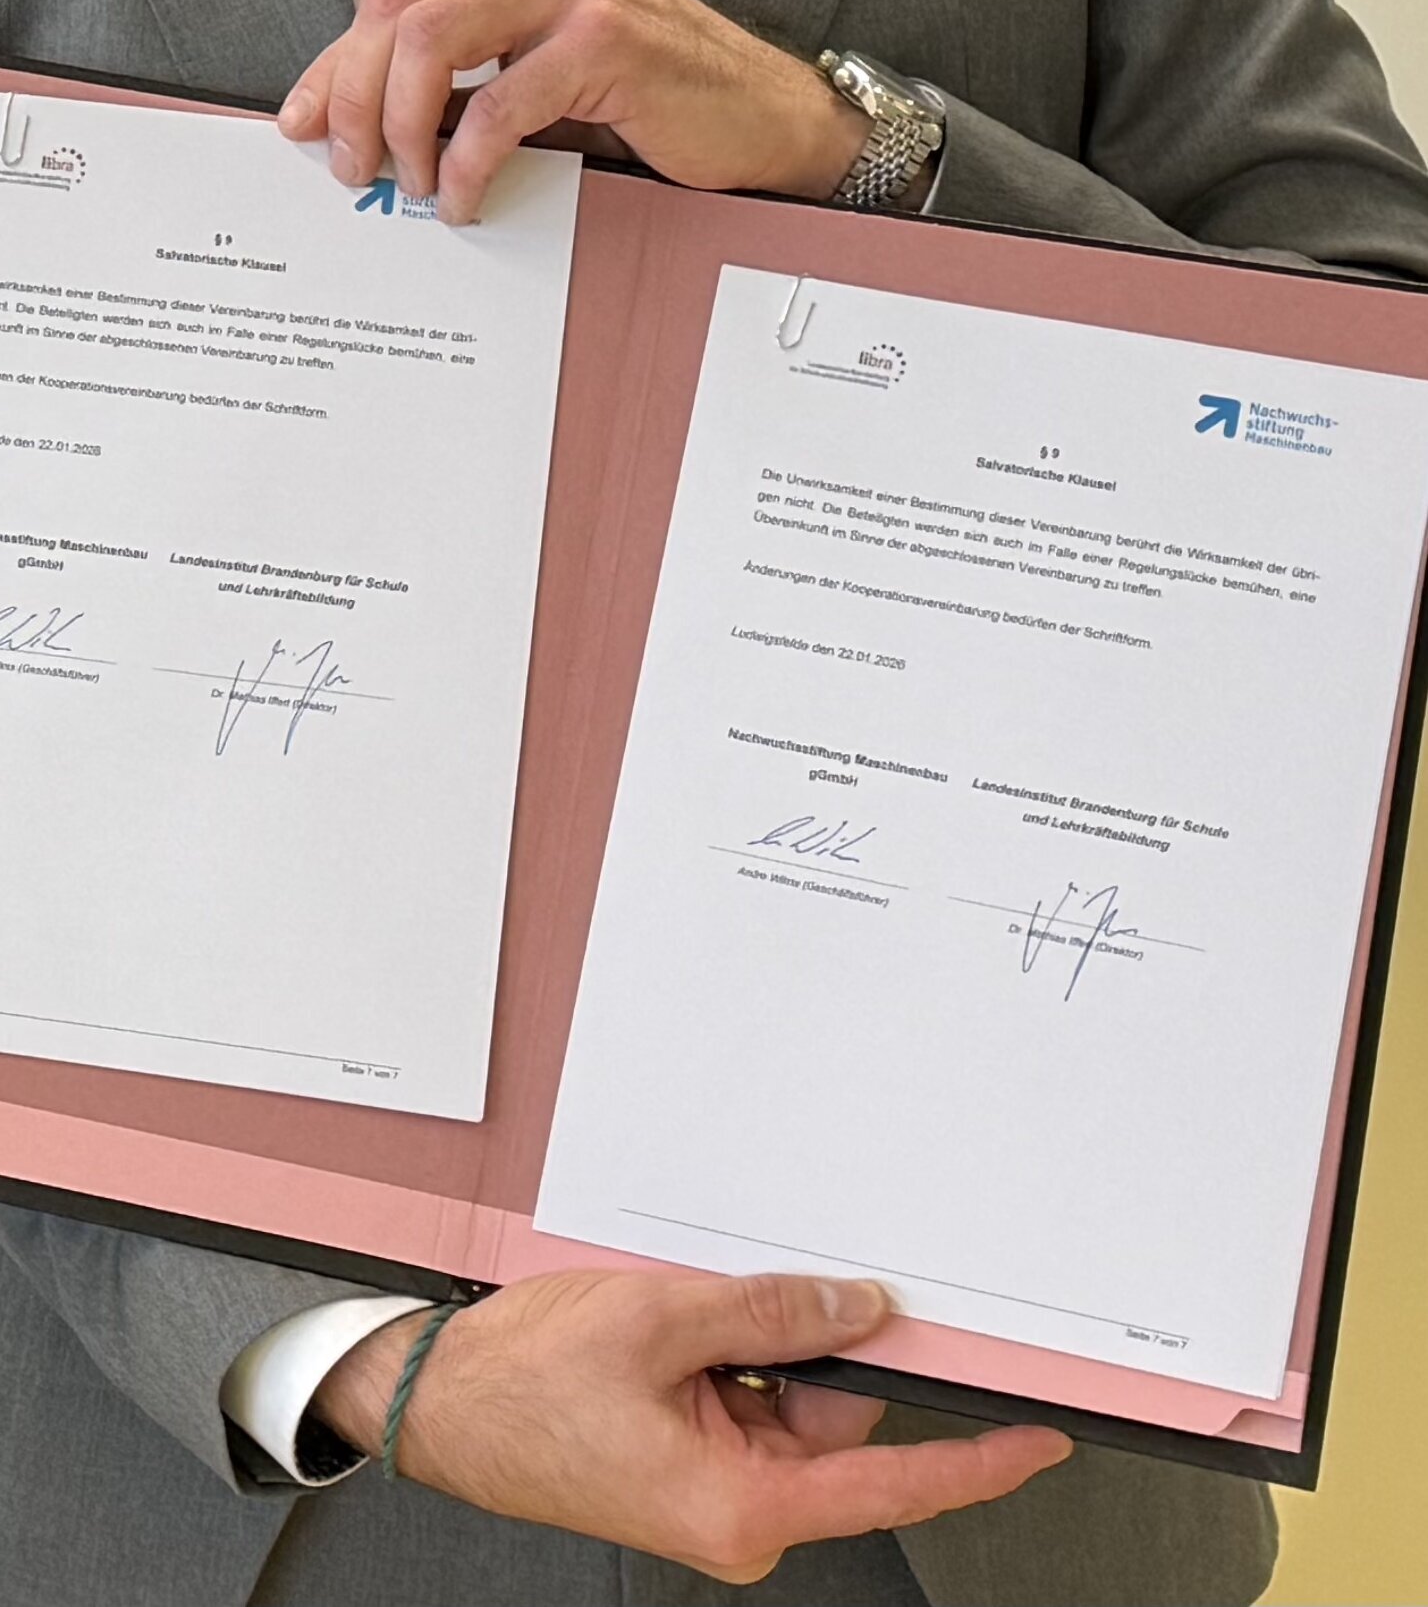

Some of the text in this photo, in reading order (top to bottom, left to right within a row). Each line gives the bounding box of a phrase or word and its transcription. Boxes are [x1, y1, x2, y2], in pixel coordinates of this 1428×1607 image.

[1245, 416, 1305, 442] stiftung
[1247, 400, 1339, 429] Nachwuchs-
[1038, 444, 1061, 460] § 9
[1243, 429, 1333, 457] Maschinenbau
[974, 455, 1117, 492] Salvatorische Klausel
[759, 466, 1320, 581] Die Unwirksamkeit einer Bestimmung dieser Vereinbarung berührt die Wirksamkeit der übri-
[752, 508, 830, 536] Übereinkunft
[830, 527, 847, 539] im
[848, 528, 886, 547] Sinne
[885, 536, 909, 551] der
[908, 541, 1016, 571] abgeschlossenen
[1017, 560, 1101, 590] Vereinbarung
[1101, 578, 1120, 591] zu
[756, 490, 781, 503] gen
[820, 500, 843, 516] Die
[845, 505, 911, 529] Beteiligten
[913, 521, 960, 538] werden
[962, 530, 989, 544] sich
[991, 535, 1024, 550] auch
[1026, 540, 1044, 554] im
[1046, 542, 1079, 561] Falle
[1080, 551, 1114, 566] einer
[1116, 555, 1218, 586] Regelungslücke
[1220, 575, 1283, 599] bemühen,
[1287, 589, 1317, 604] eine
[741, 558, 817, 585] Änderungen
[817, 575, 841, 590] der
[840, 578, 1002, 624] Kooperationsvereinbarung
[1001, 610, 1058, 631] bedürfen
[1057, 621, 1082, 636] der
[810, 641, 836, 656] den
[726, 726, 949, 783] Nachwuchsstiftung Maschinenbau
[807, 767, 859, 788] gGmbH
[970, 776, 1230, 839] Landesinstitut Brandenburg für Schule
[1021, 812, 1171, 853] und Lehrkräftebildung
